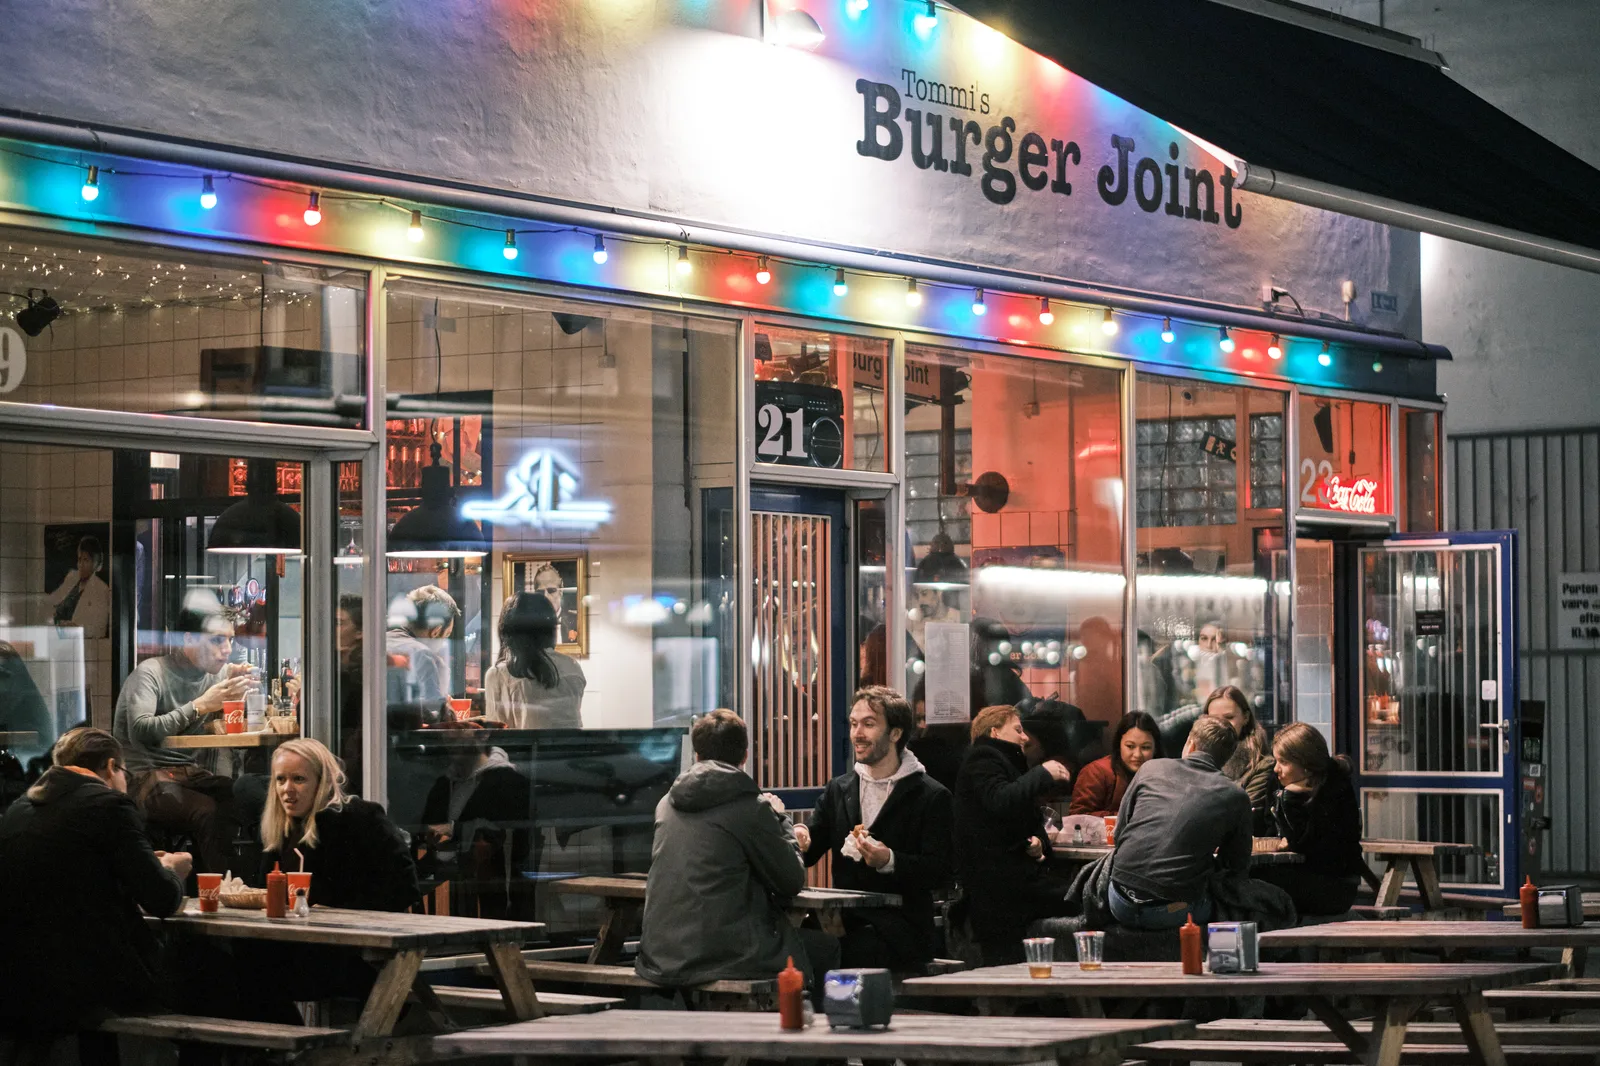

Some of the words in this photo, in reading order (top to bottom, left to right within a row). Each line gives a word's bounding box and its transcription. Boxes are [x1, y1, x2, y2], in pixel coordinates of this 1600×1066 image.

[901, 68, 990, 115] Tommi's
[855, 78, 1081, 205] Burger
[1096, 133, 1243, 230] Joint
[757, 403, 808, 458] 21
[1300, 457, 1333, 504] 23
